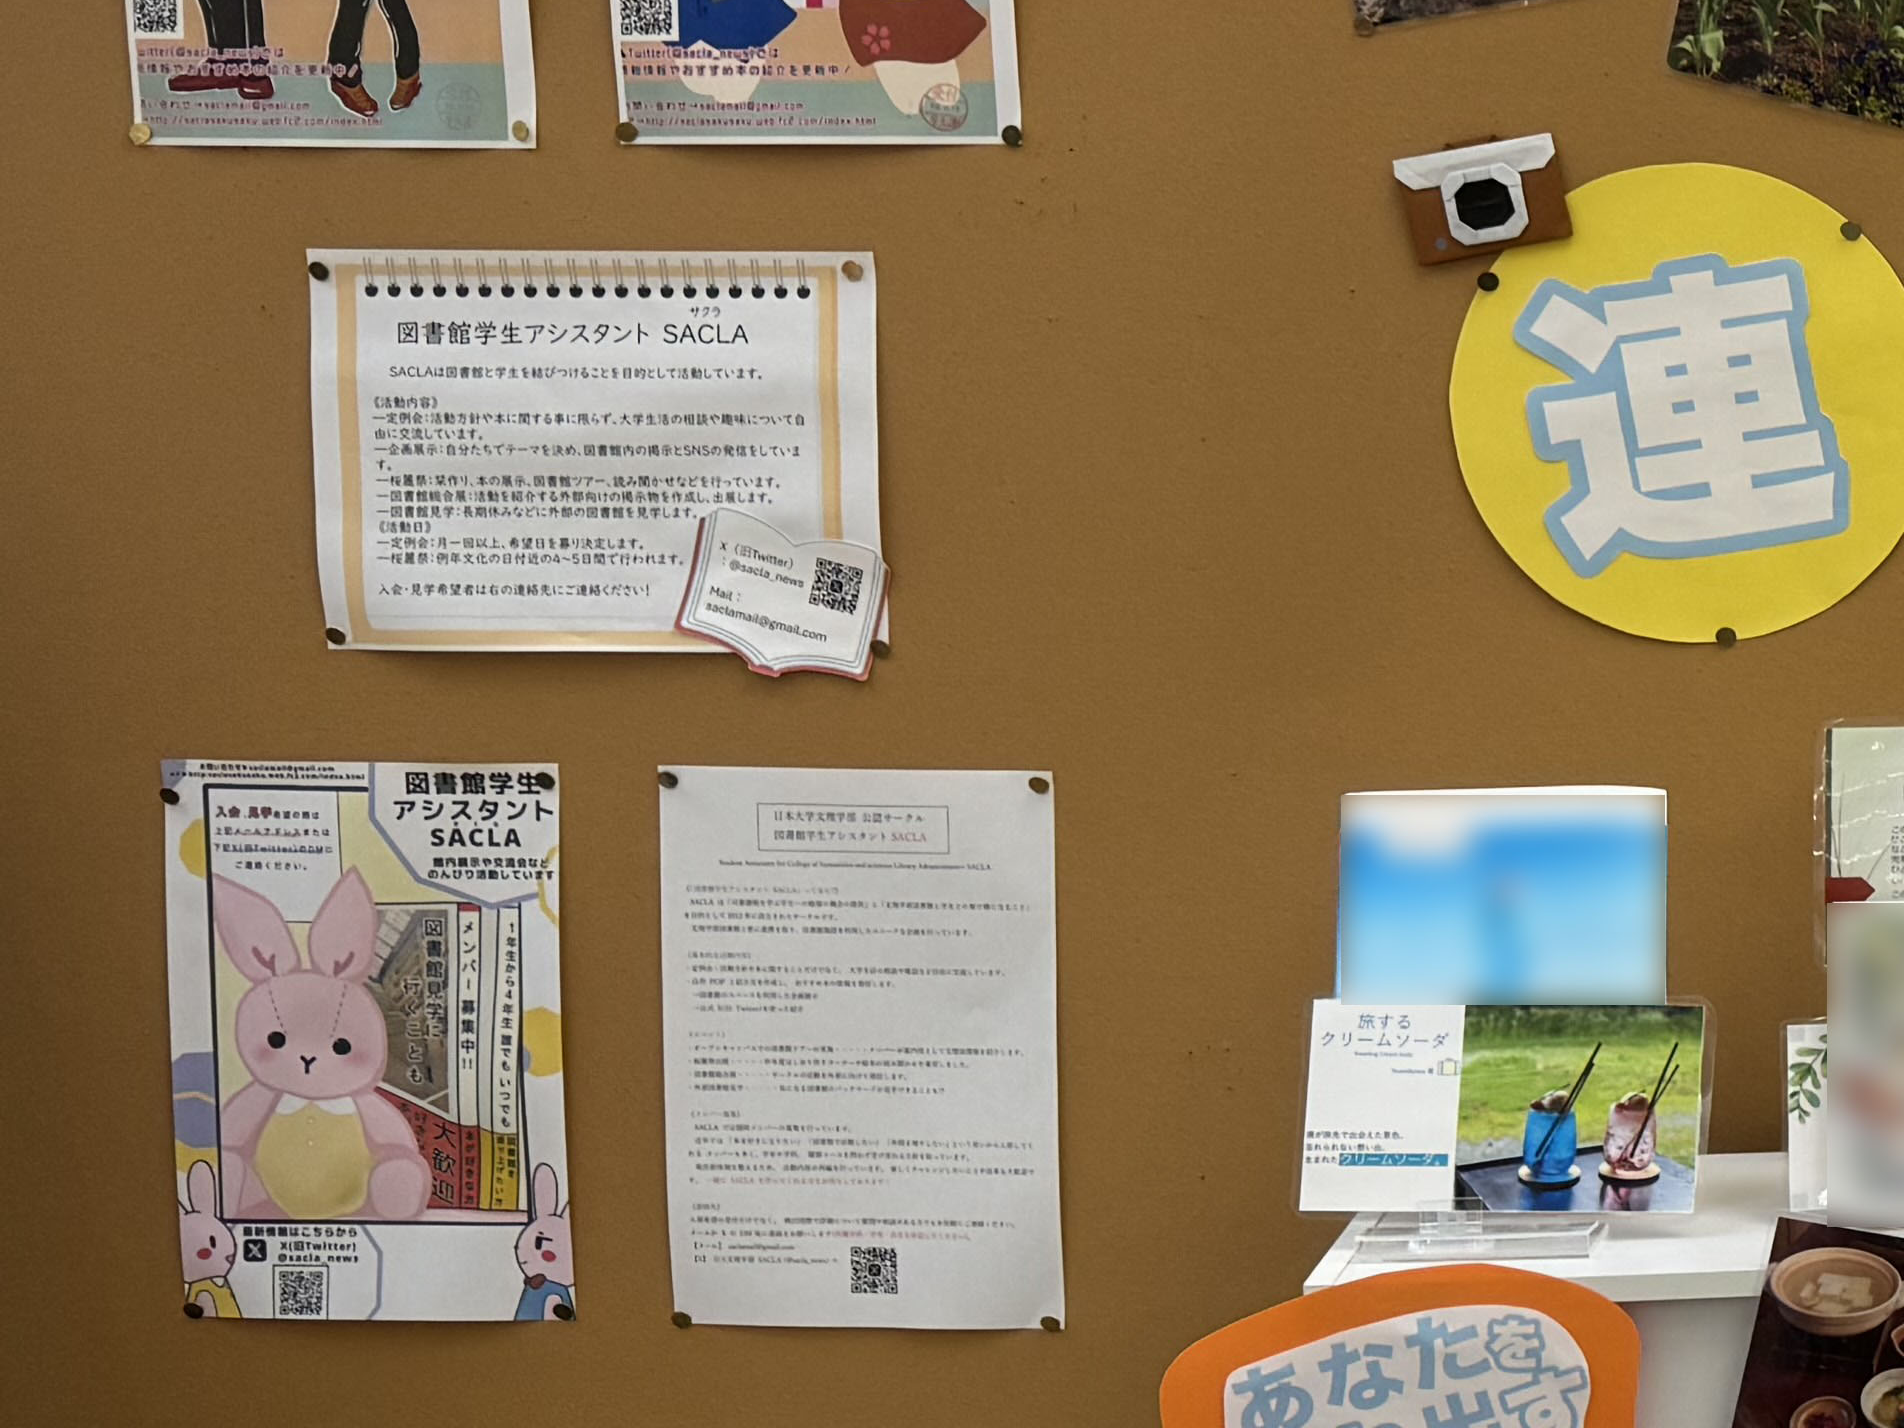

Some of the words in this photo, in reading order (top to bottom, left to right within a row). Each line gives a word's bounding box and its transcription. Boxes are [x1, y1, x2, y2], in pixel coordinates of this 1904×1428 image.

[689, 306, 722, 319] サクラ
[397, 322, 650, 345] 図書館学生アシスタント
[663, 324, 749, 345] SACLA
[405, 772, 542, 797] 図書館学生
[393, 799, 554, 822] アシスタント
[430, 826, 522, 848] SACLA
[424, 918, 445, 1038] 図書館見学に
[1358, 1014, 1411, 1029] 旅する
[1321, 1032, 1449, 1048] クリームソーダ
